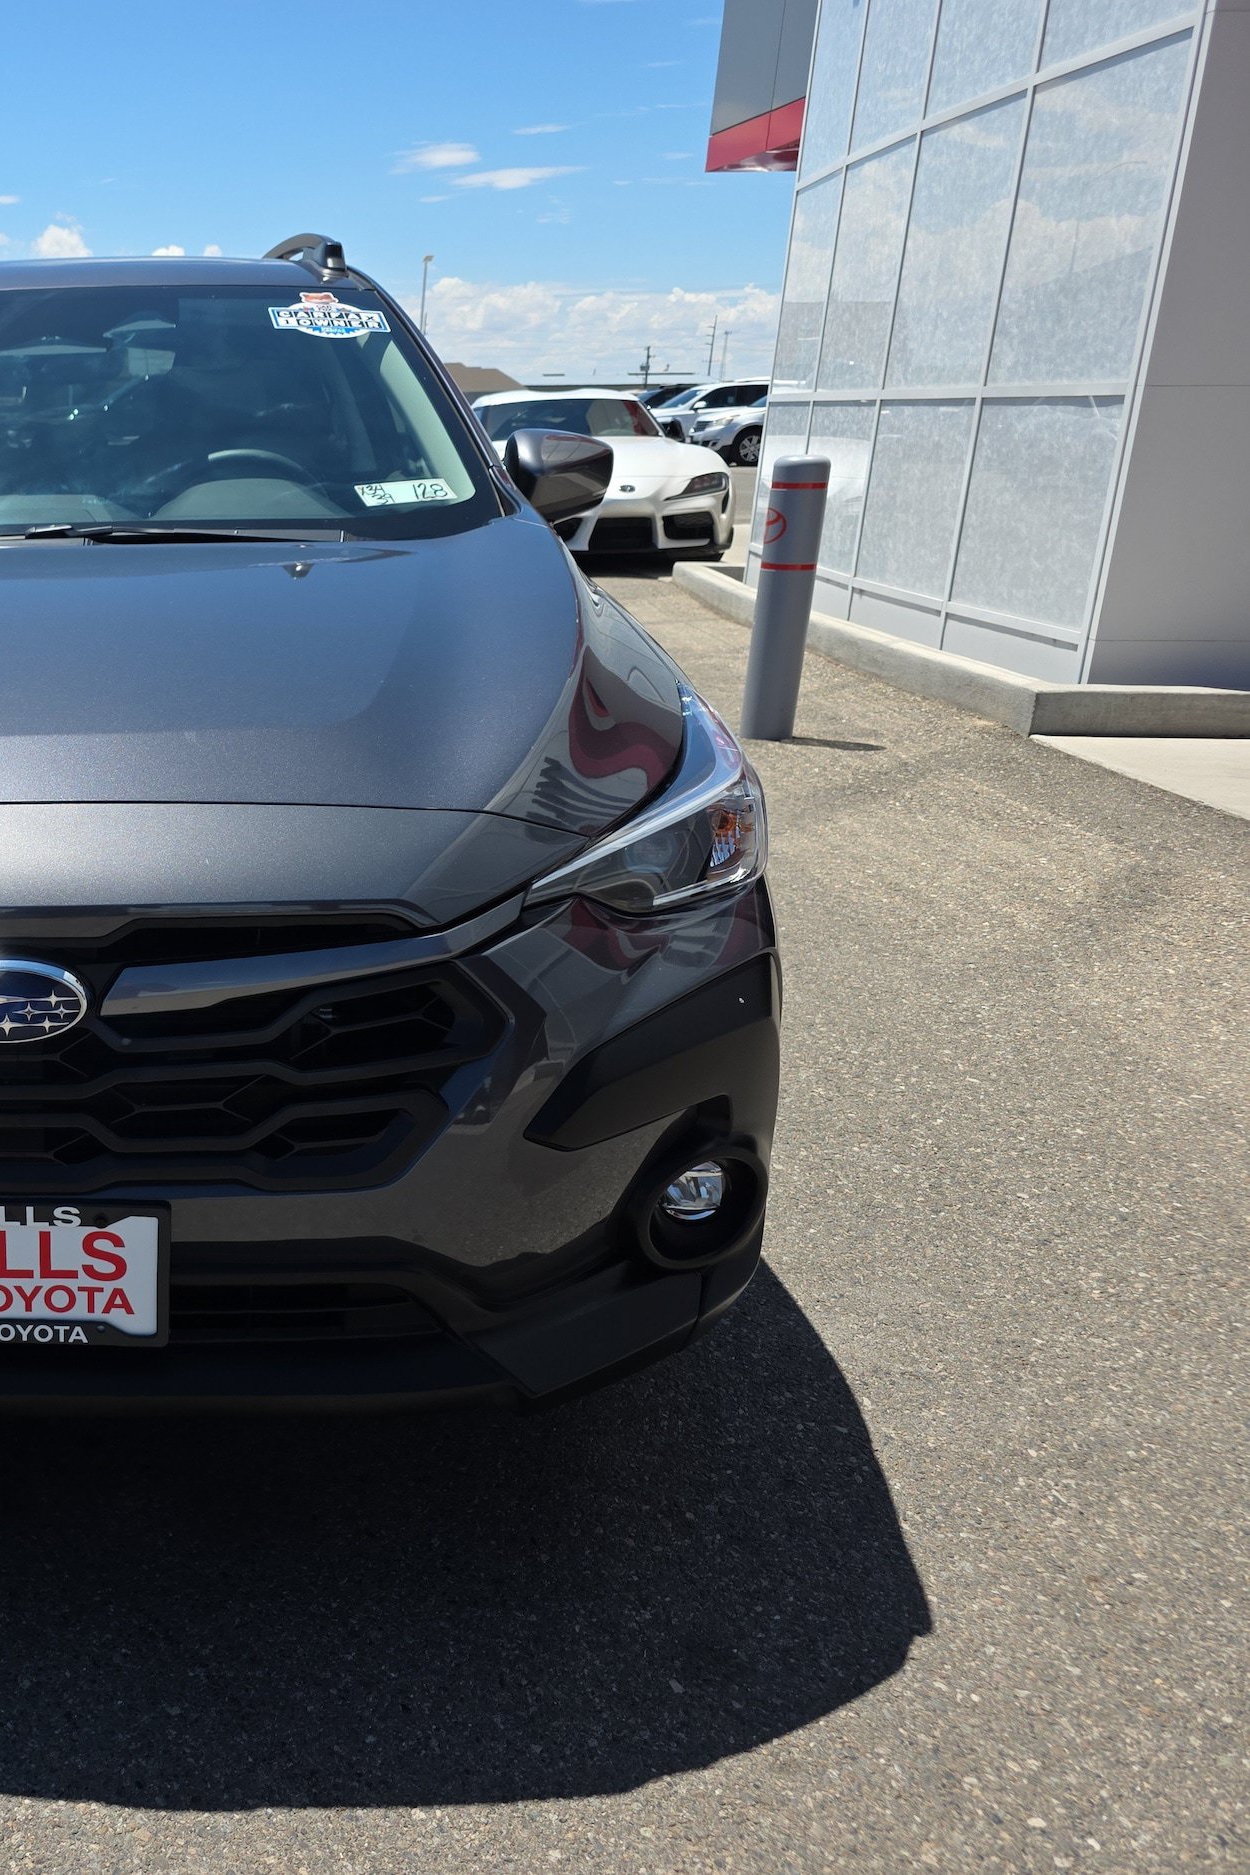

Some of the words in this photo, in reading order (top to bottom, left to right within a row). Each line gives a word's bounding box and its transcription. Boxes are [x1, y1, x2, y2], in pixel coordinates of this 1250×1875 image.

[278, 310, 378, 321] CARFAX
[297, 319, 380, 329] OWNER
[413, 482, 448, 500] 128
